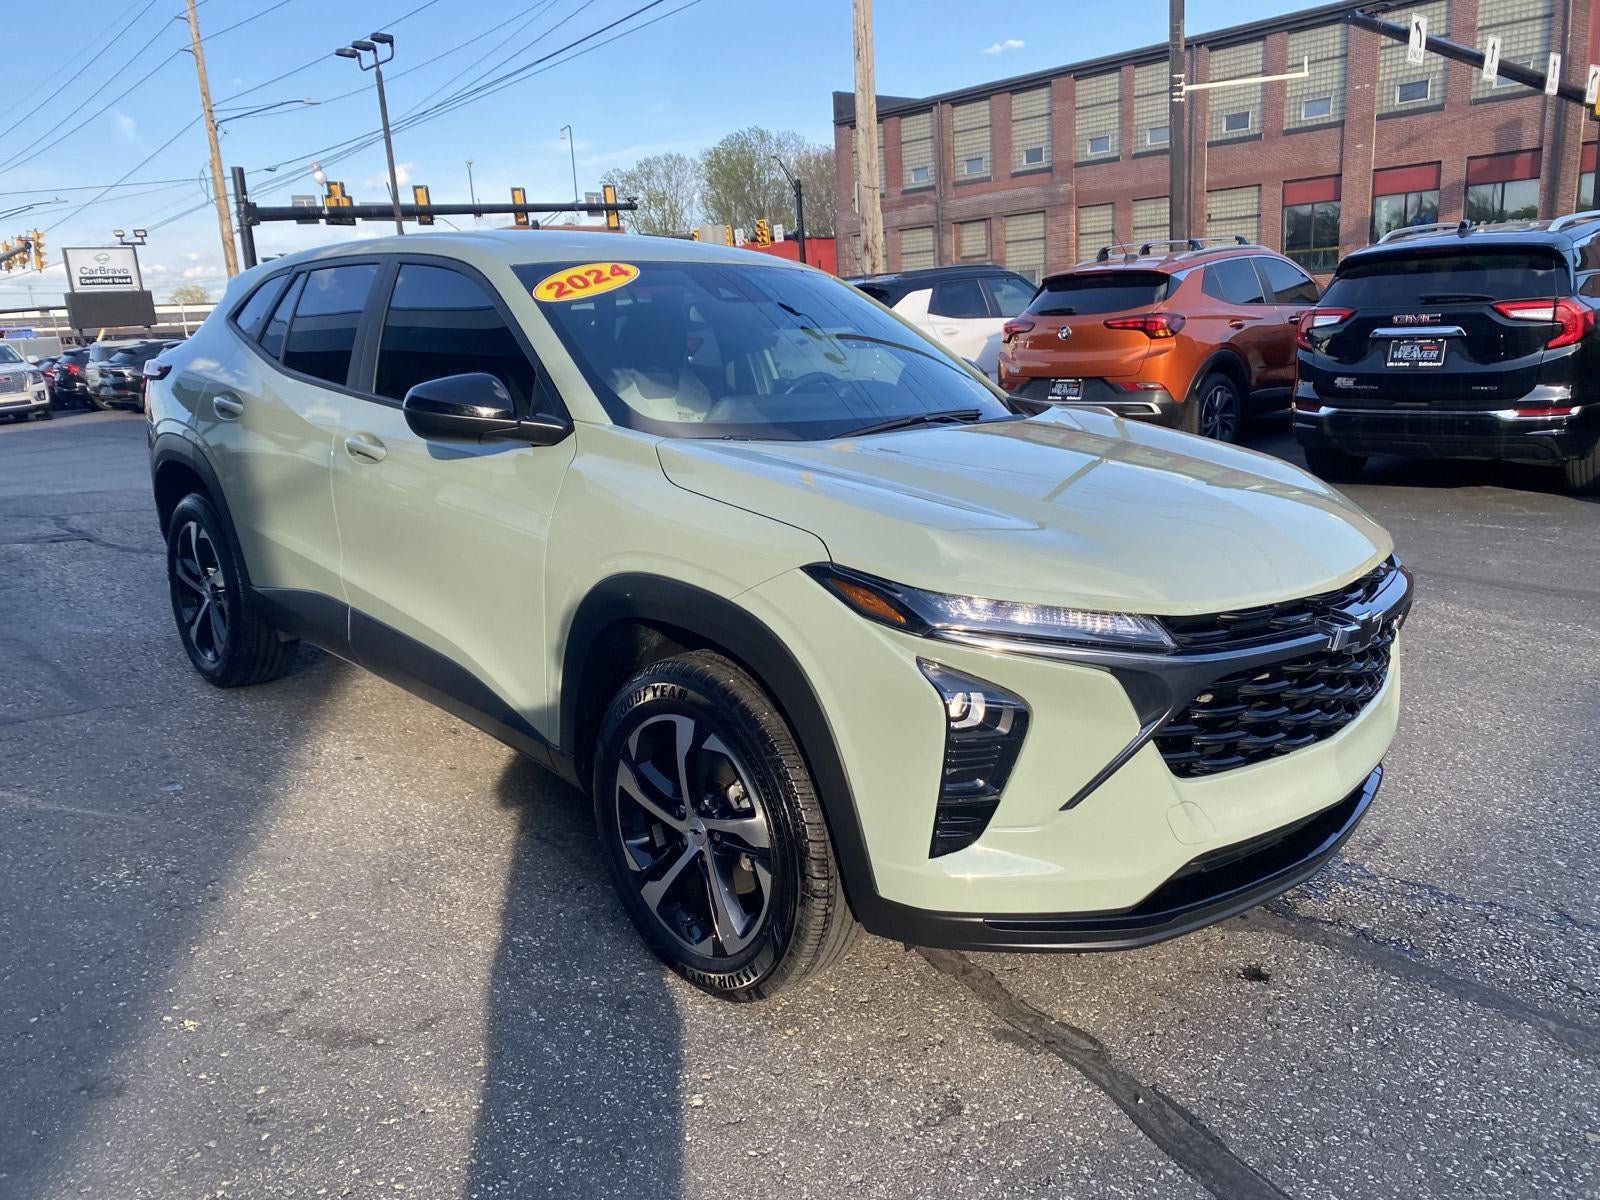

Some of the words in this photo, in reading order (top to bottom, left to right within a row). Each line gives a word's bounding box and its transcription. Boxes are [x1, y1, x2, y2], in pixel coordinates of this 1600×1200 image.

[79, 266, 129, 275] CarBravo
[545, 263, 632, 299] 2024
[1392, 313, 1441, 324] GMC
[1393, 350, 1439, 358] WEAVER
